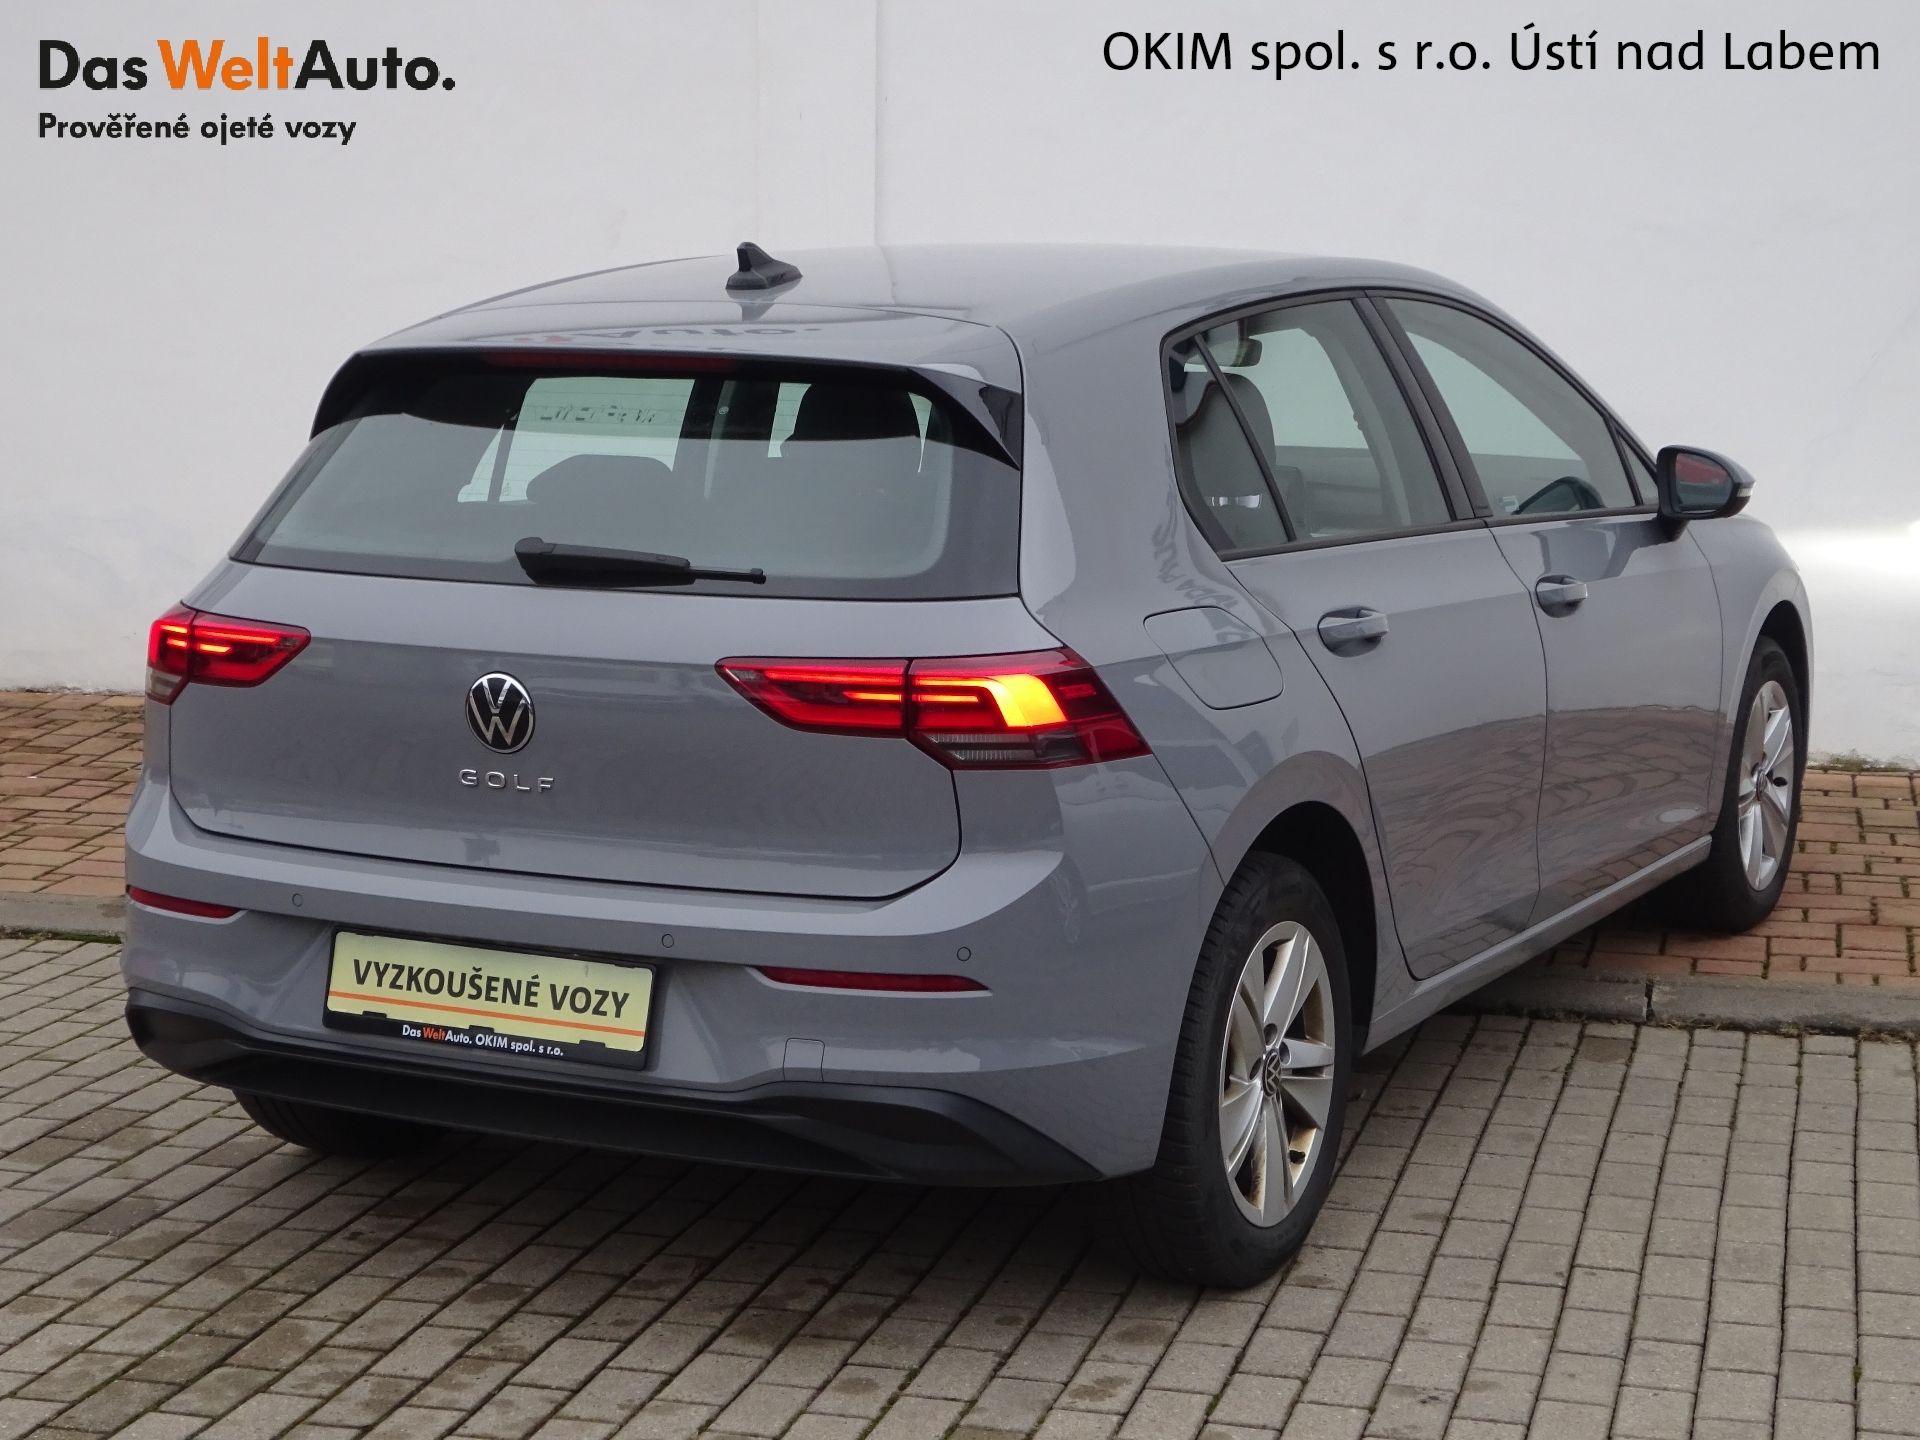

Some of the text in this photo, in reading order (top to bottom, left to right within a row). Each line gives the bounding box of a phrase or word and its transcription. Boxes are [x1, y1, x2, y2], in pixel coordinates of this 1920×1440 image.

[459, 769, 554, 792] GOLF
[353, 958, 630, 1018] VYZKOUŠENÉ VOZY
[402, 1024, 564, 1056] Das WeltAuto. OKIM spol. s r.o.
